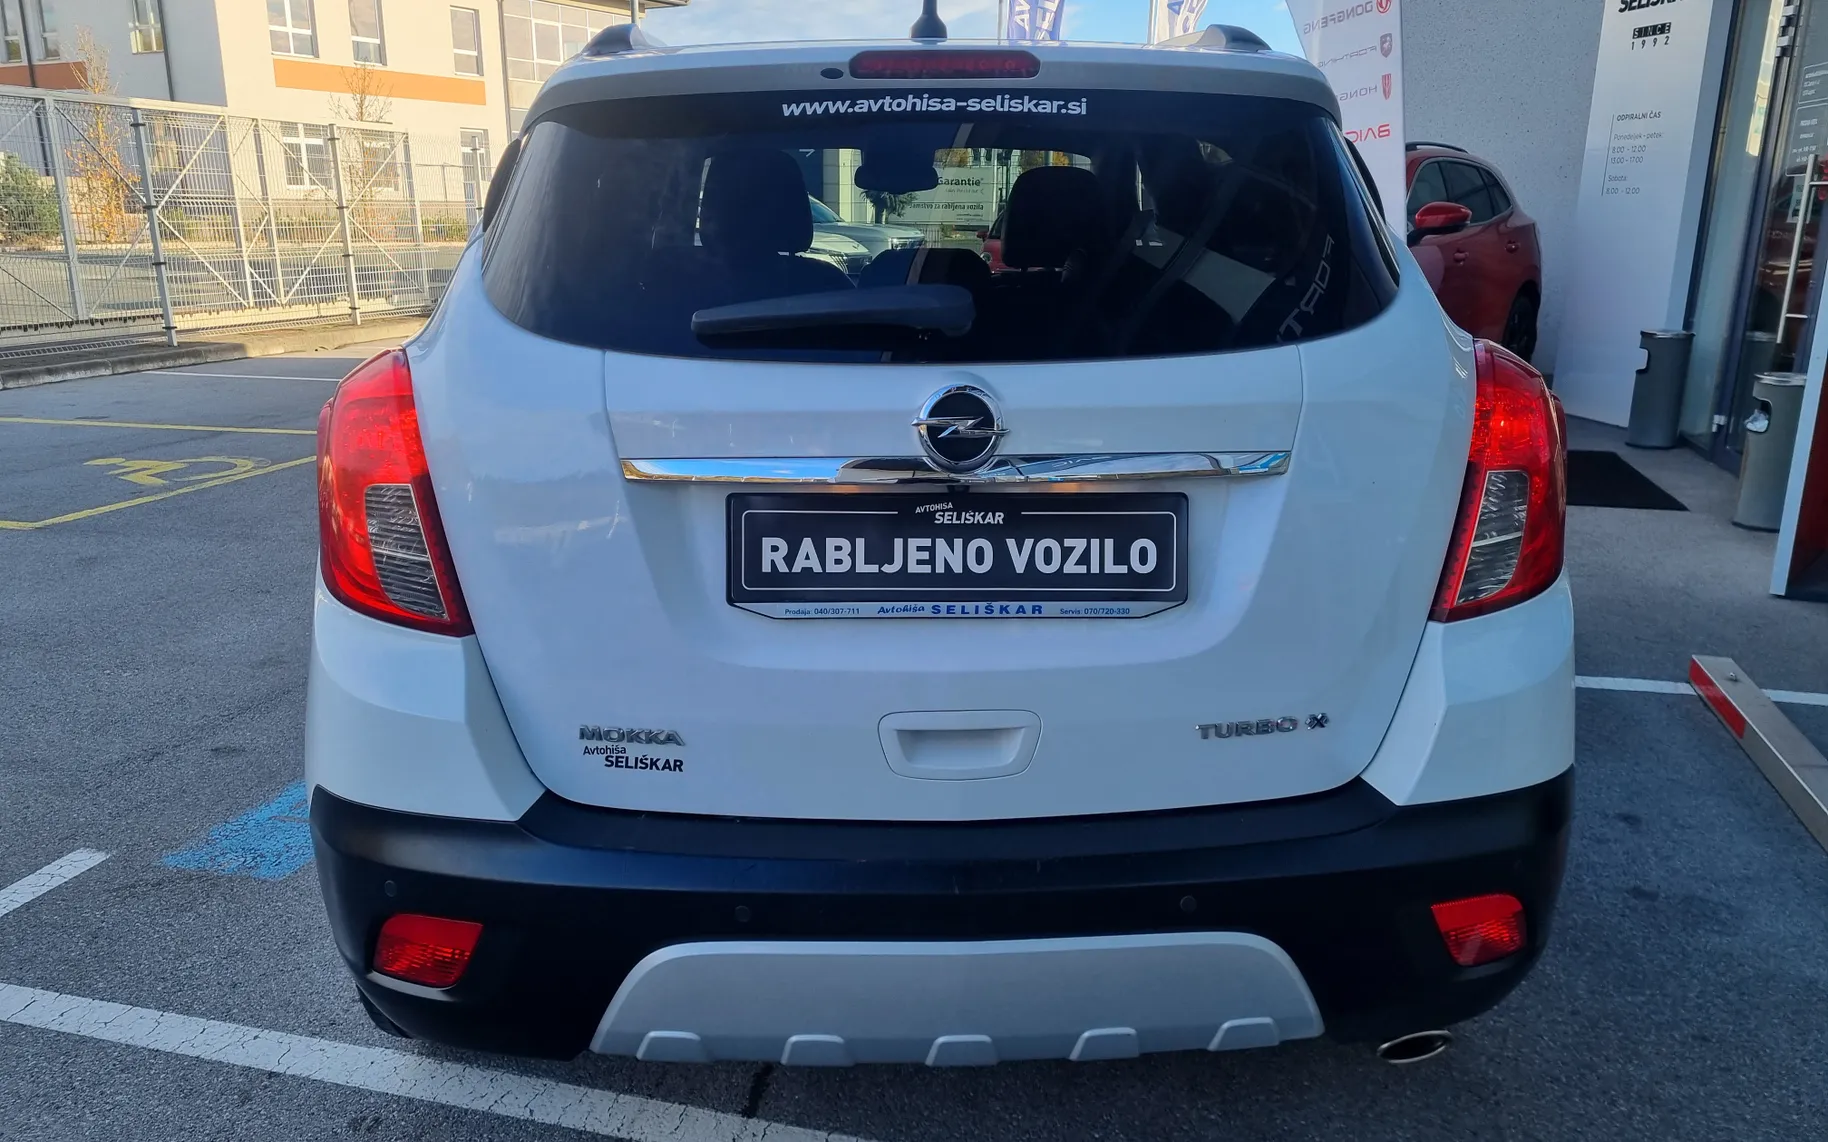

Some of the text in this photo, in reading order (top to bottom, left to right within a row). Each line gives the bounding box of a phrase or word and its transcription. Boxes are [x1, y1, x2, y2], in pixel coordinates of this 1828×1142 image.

[1633, 22, 1671, 39] SINCE
[1631, 35, 1670, 51] 1992
[782, 94, 1087, 116] www.avtohisa-seliskar.si
[1616, 110, 1662, 121] ODPIRALNI ČAS
[934, 510, 1004, 524] SELIŠKAR
[761, 537, 1157, 574] RABLJENO VOZILO
[931, 602, 1043, 615] SELIŠKAR
[579, 724, 686, 746] MOKKA
[1195, 716, 1298, 740] TURBO
[583, 744, 627, 755] Avtohiša
[604, 754, 684, 772] SELIŠKAR
